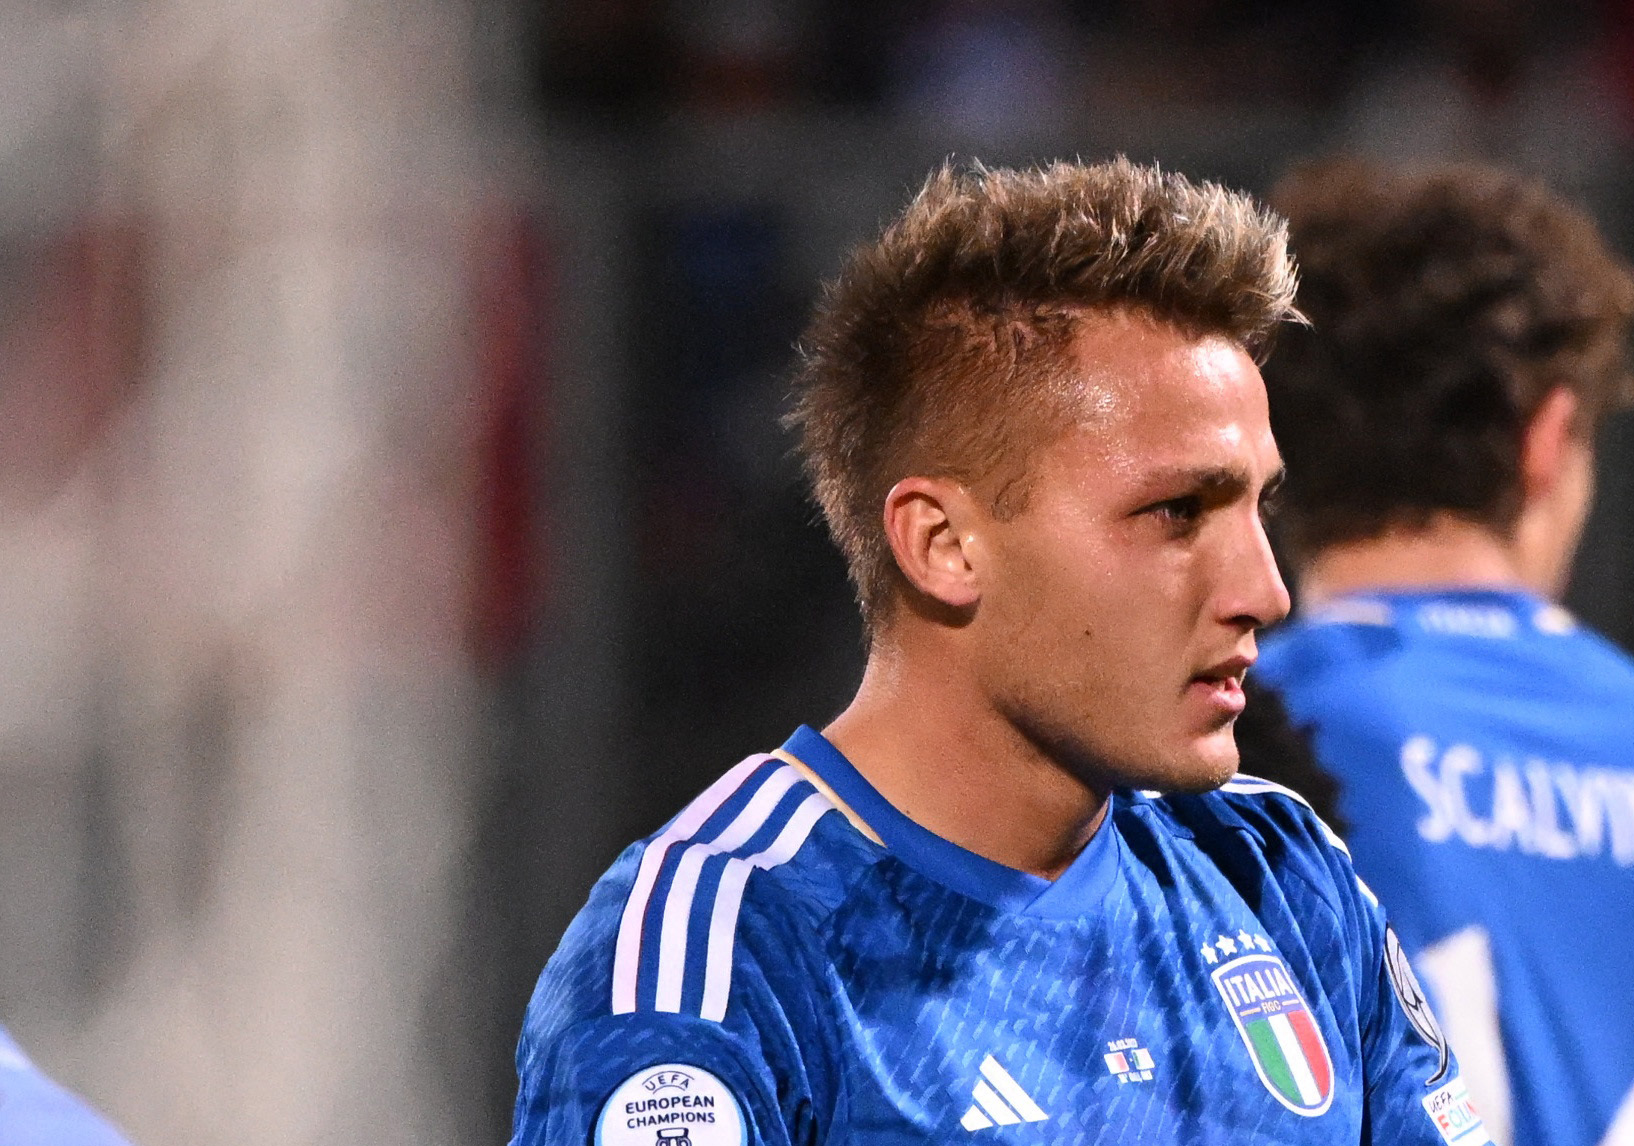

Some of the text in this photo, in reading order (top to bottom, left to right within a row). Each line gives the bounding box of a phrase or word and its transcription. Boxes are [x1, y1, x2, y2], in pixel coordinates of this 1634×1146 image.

[1223, 967, 1295, 1007] ITALIA
[1261, 1000, 1281, 1014] FIGC
[645, 1073, 690, 1092] UEFA
[625, 1095, 715, 1114] EUROPEAN
[1428, 1090, 1455, 1114] UEFA
[626, 1111, 716, 1129] CHAMPIONS
